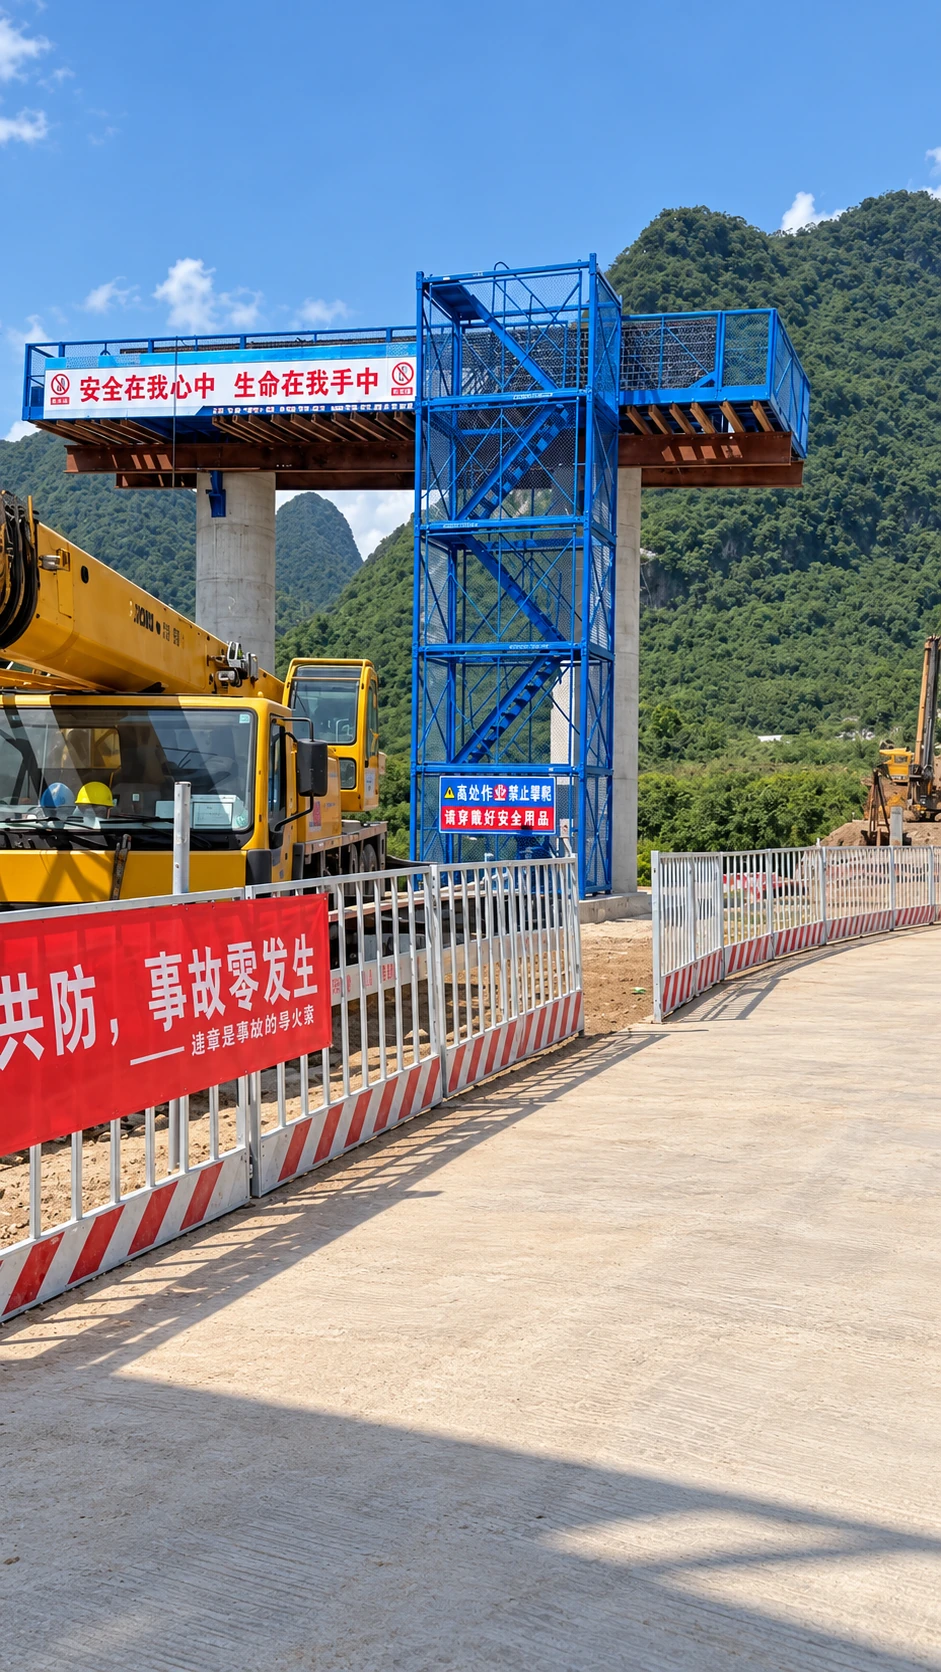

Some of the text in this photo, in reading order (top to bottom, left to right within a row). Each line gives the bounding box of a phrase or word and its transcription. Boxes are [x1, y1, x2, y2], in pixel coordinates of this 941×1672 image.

[80, 367, 378, 403] 安全在我心中 生命在我手中
